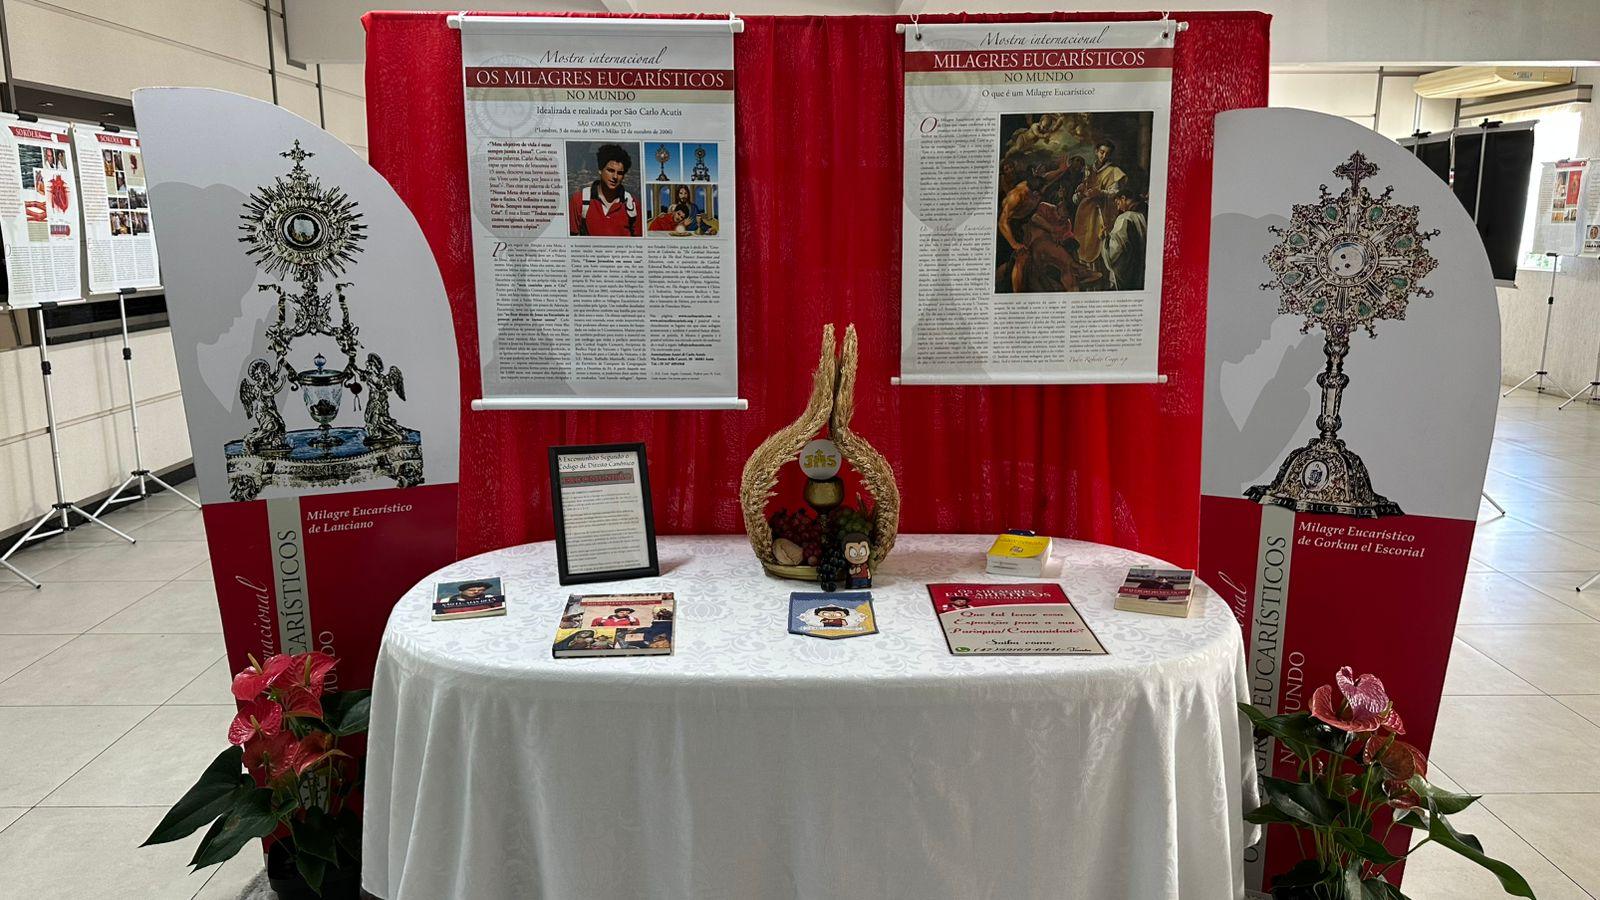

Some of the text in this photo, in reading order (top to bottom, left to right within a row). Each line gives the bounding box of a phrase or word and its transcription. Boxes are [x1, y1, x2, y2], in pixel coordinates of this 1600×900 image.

[980, 26, 1110, 47] Mostra internacional
[540, 46, 667, 64] Mostra internacional
[934, 49, 1145, 69] MILAGRES EUCARÍSTICOS
[476, 68, 724, 88] OS MILAGRES EUCARÍSTICOS
[1004, 71, 1074, 83] NO MUNDO
[566, 90, 636, 101] NO MUNDO
[982, 90, 990, 98] O
[991, 91, 1004, 100] que
[1026, 88, 1052, 99] Milagre
[1054, 87, 1096, 96] Eucarístico?
[536, 106, 571, 115] Idealizada
[578, 106, 608, 115] realizada
[610, 109, 622, 118] por
[624, 108, 637, 116] São
[639, 108, 659, 116] Carlo
[660, 108, 682, 116] Acutis
[306, 502, 412, 522] Milagre Eucarístico
[308, 520, 374, 534] de Lanciano
[1298, 522, 1415, 542] Milagre Eucarístico
[1298, 537, 1425, 558] de Gorkun el Escorial
[277, 530, 308, 655] CARÍSTICOS
[960, 610, 985, 618] Que
[1253, 536, 1287, 710] EUCARÍSTICOS
[1284, 651, 1305, 713] UNDO
